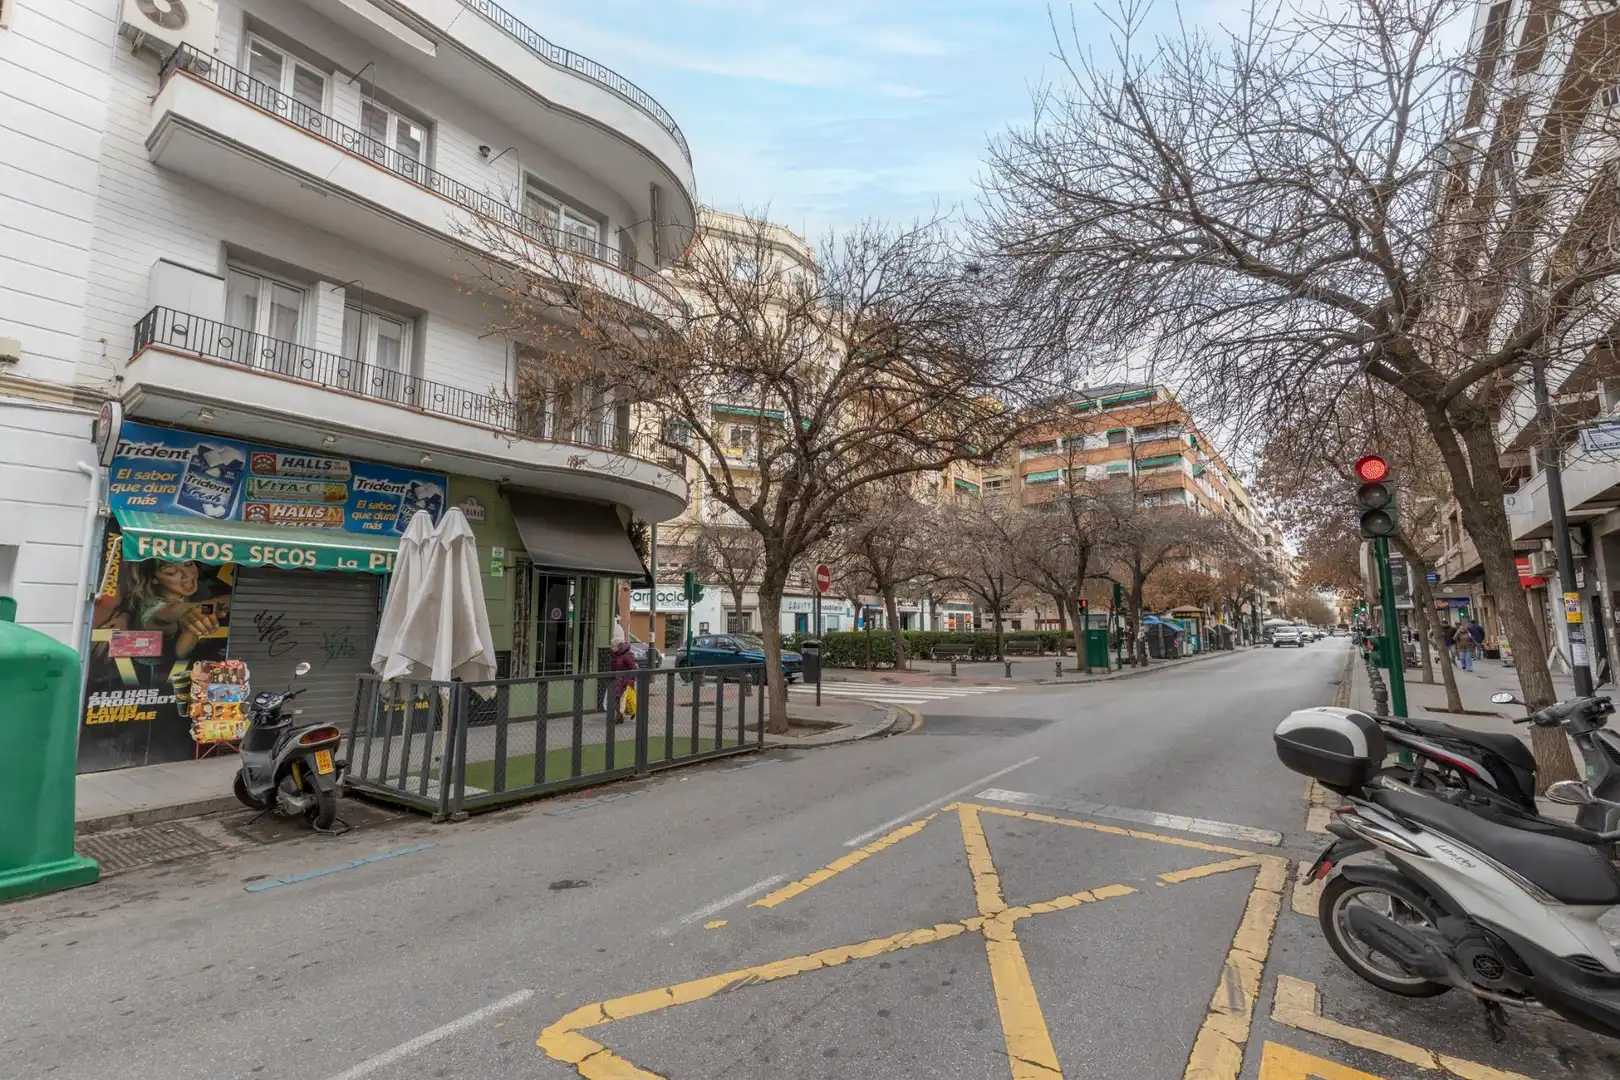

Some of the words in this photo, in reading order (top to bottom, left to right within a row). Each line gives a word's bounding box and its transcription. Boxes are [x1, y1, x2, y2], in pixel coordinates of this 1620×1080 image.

[116, 443, 190, 460] Trident
[281, 457, 332, 470] HALLS
[116, 468, 132, 480] El
[134, 470, 177, 482] sabor
[110, 483, 142, 494] que
[144, 482, 177, 494] dura
[185, 474, 230, 494] Trident
[357, 479, 406, 494] Trident
[127, 493, 158, 506] más
[356, 500, 367, 509] El
[368, 501, 397, 511] sabor
[274, 505, 326, 519] HALLS
[352, 511, 372, 521] que
[373, 510, 398, 521] dura
[362, 520, 384, 530] más
[138, 536, 233, 561] FRUTOS
[250, 545, 317, 567] SECOS
[338, 556, 358, 569] La
[124, 688, 159, 699] HAS
[87, 695, 176, 709] PROBADO?
